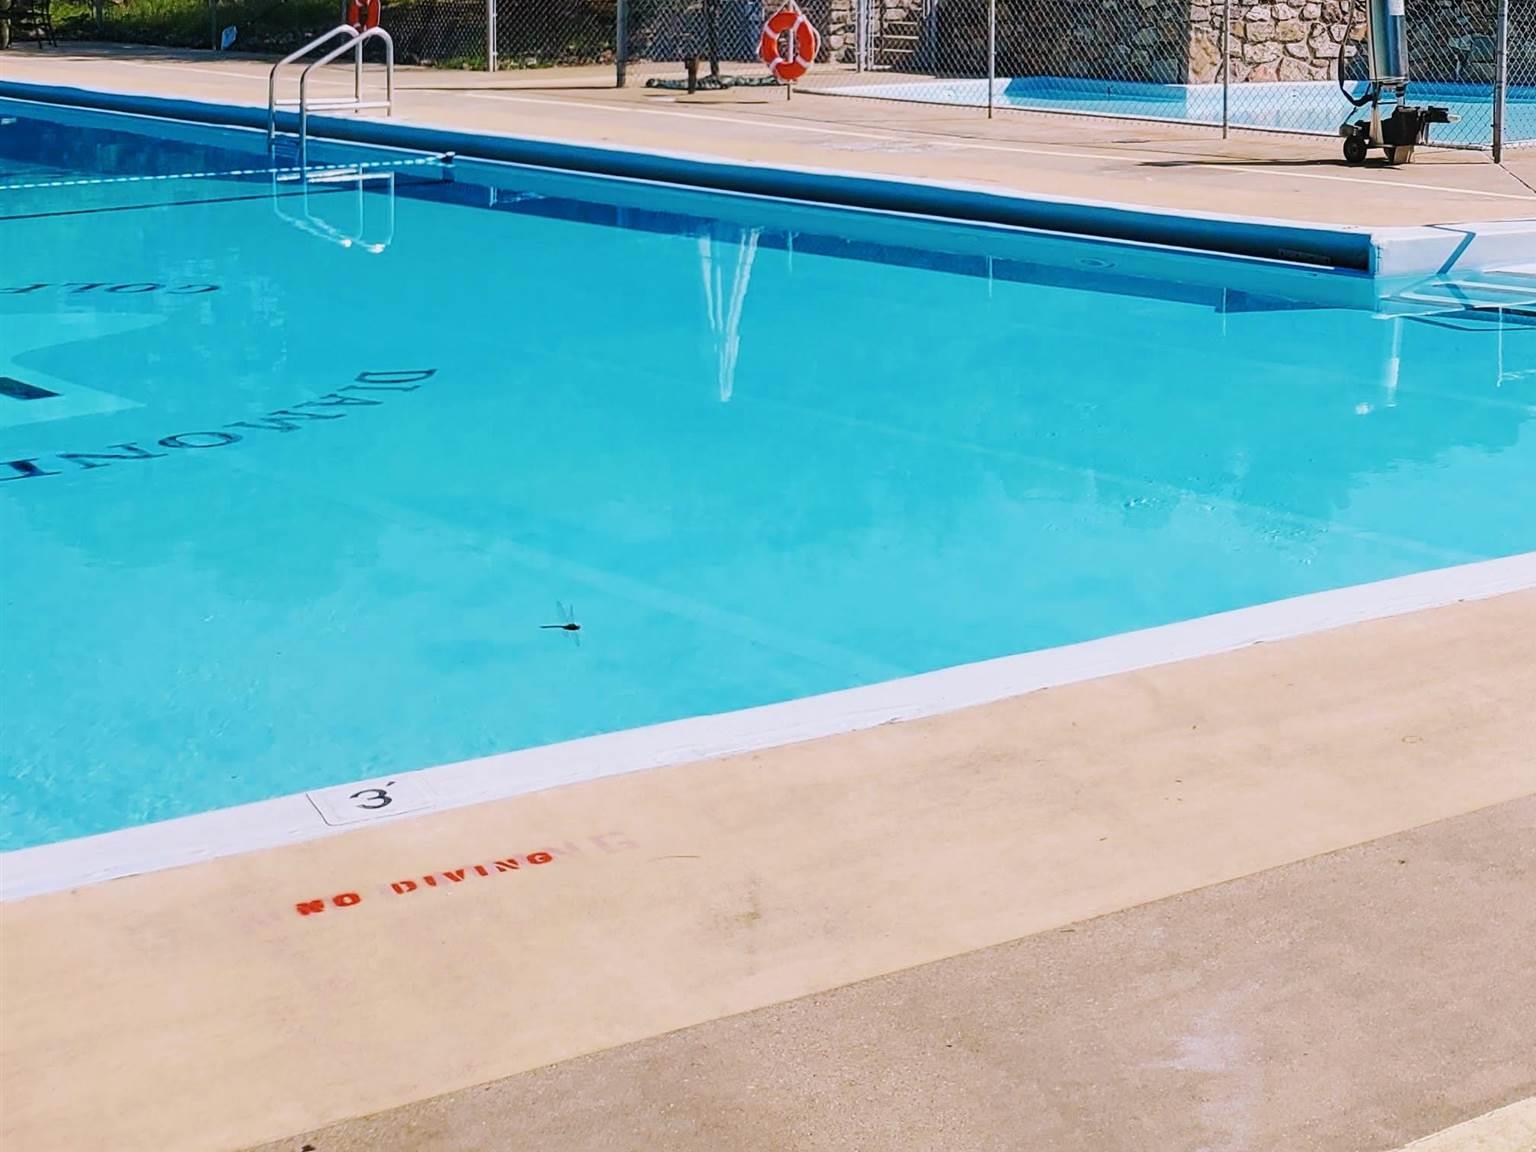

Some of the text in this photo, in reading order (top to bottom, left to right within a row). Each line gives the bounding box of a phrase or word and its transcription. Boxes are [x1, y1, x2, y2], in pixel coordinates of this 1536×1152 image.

[0, 282, 221, 294] GOLF
[296, 852, 553, 916] NO DIVING
